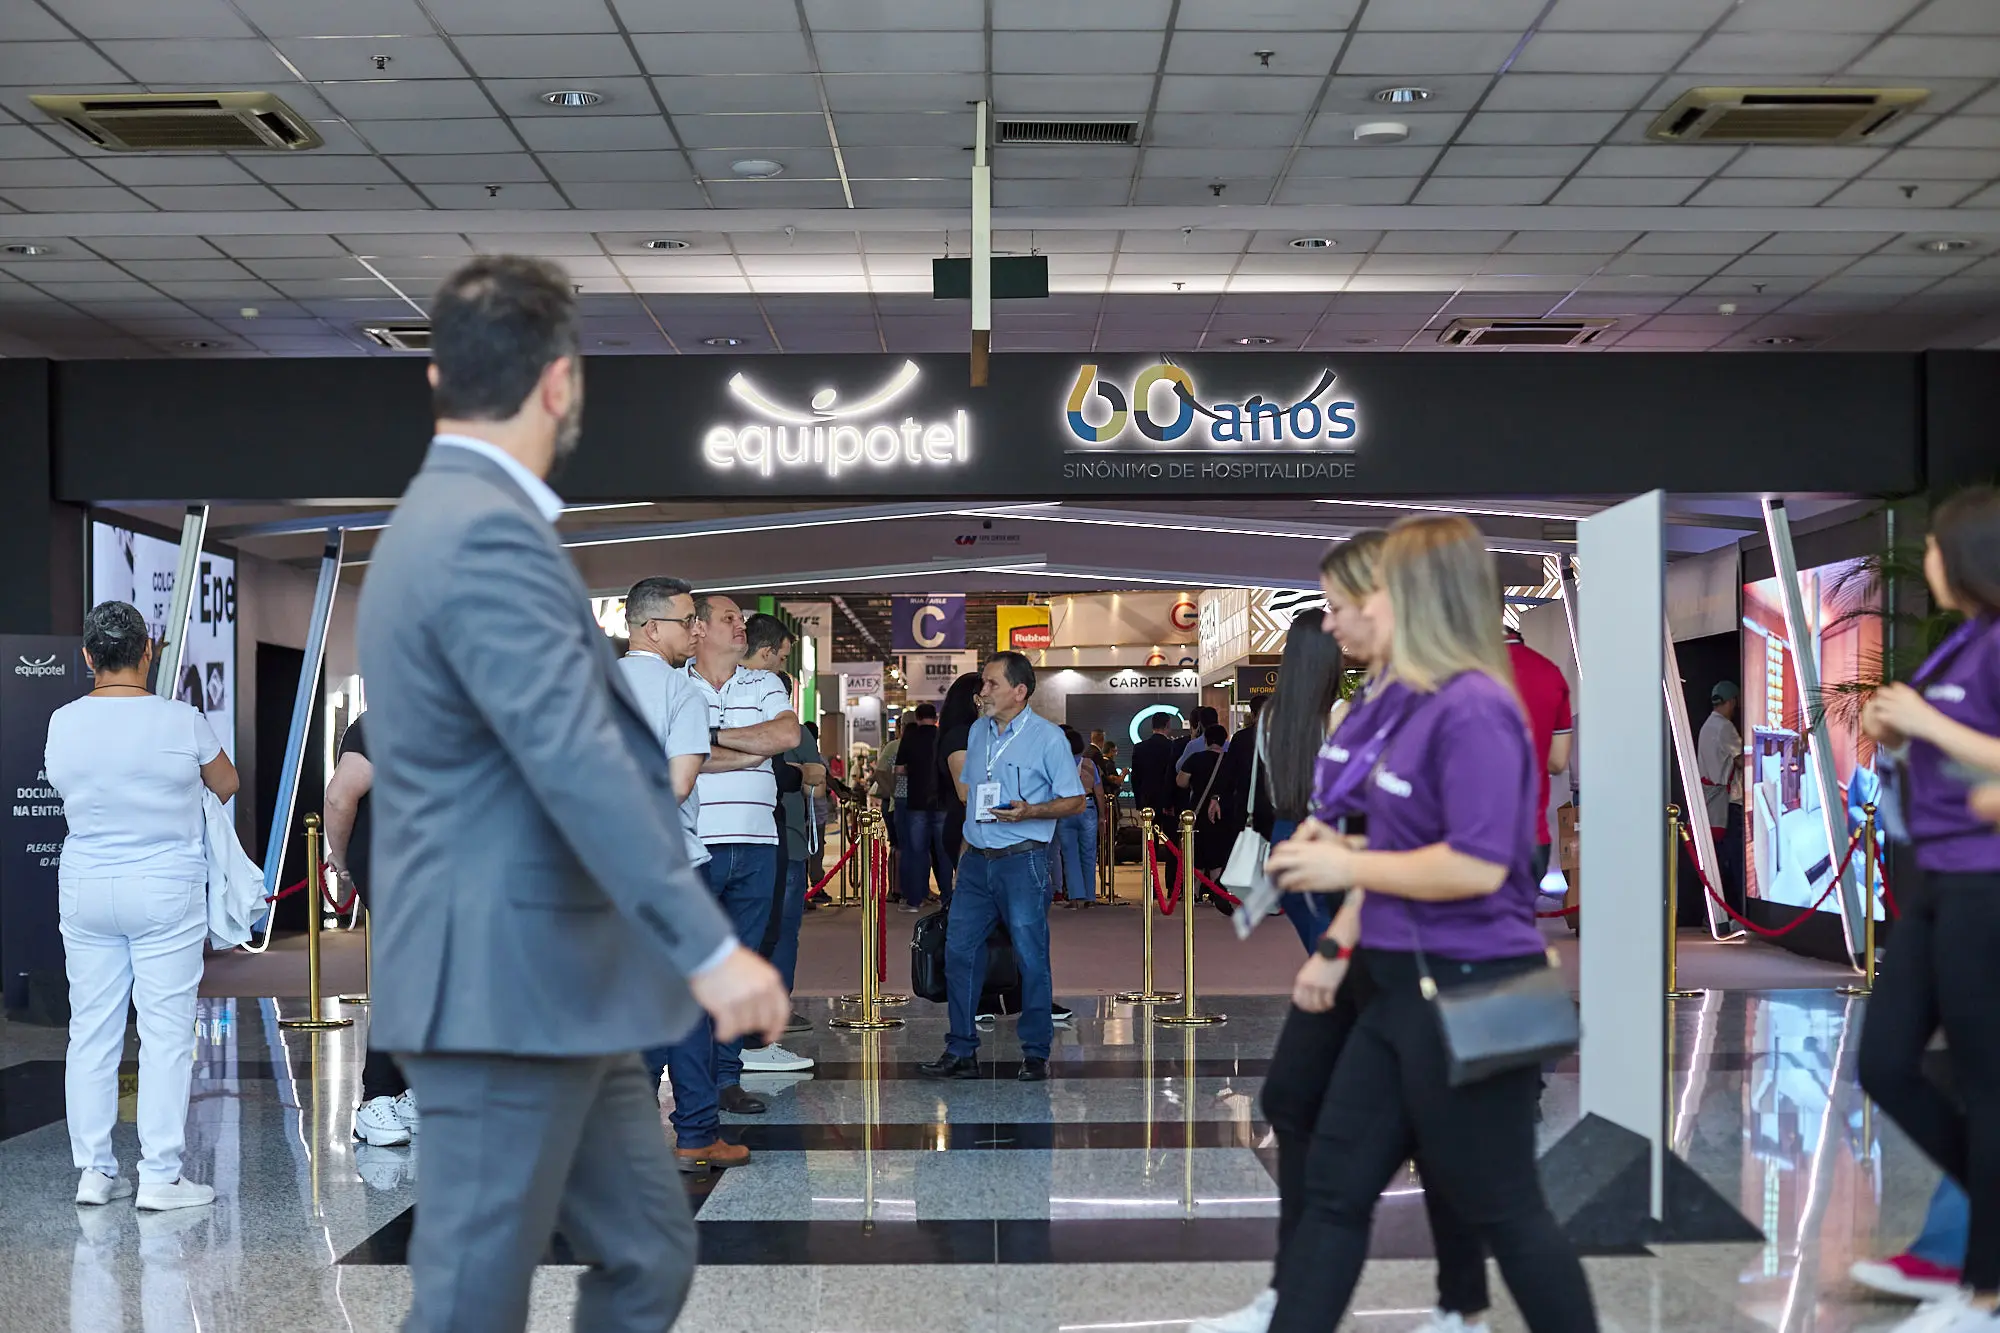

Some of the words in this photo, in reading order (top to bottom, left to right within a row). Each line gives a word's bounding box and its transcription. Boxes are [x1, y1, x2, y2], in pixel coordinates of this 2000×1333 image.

[1066, 363, 1195, 442] 60
[1210, 400, 1357, 442] anos
[703, 408, 969, 477] equipotel
[1063, 460, 1163, 479] SINÔNIMO
[1168, 463, 1195, 479] DE
[1201, 462, 1356, 479] HOSPITALIDADE
[911, 605, 946, 649] C
[14, 663, 66, 678] equipotel
[13, 805, 30, 817] NA
[26, 843, 57, 853] PLEASE
[39, 857, 50, 867] ID
